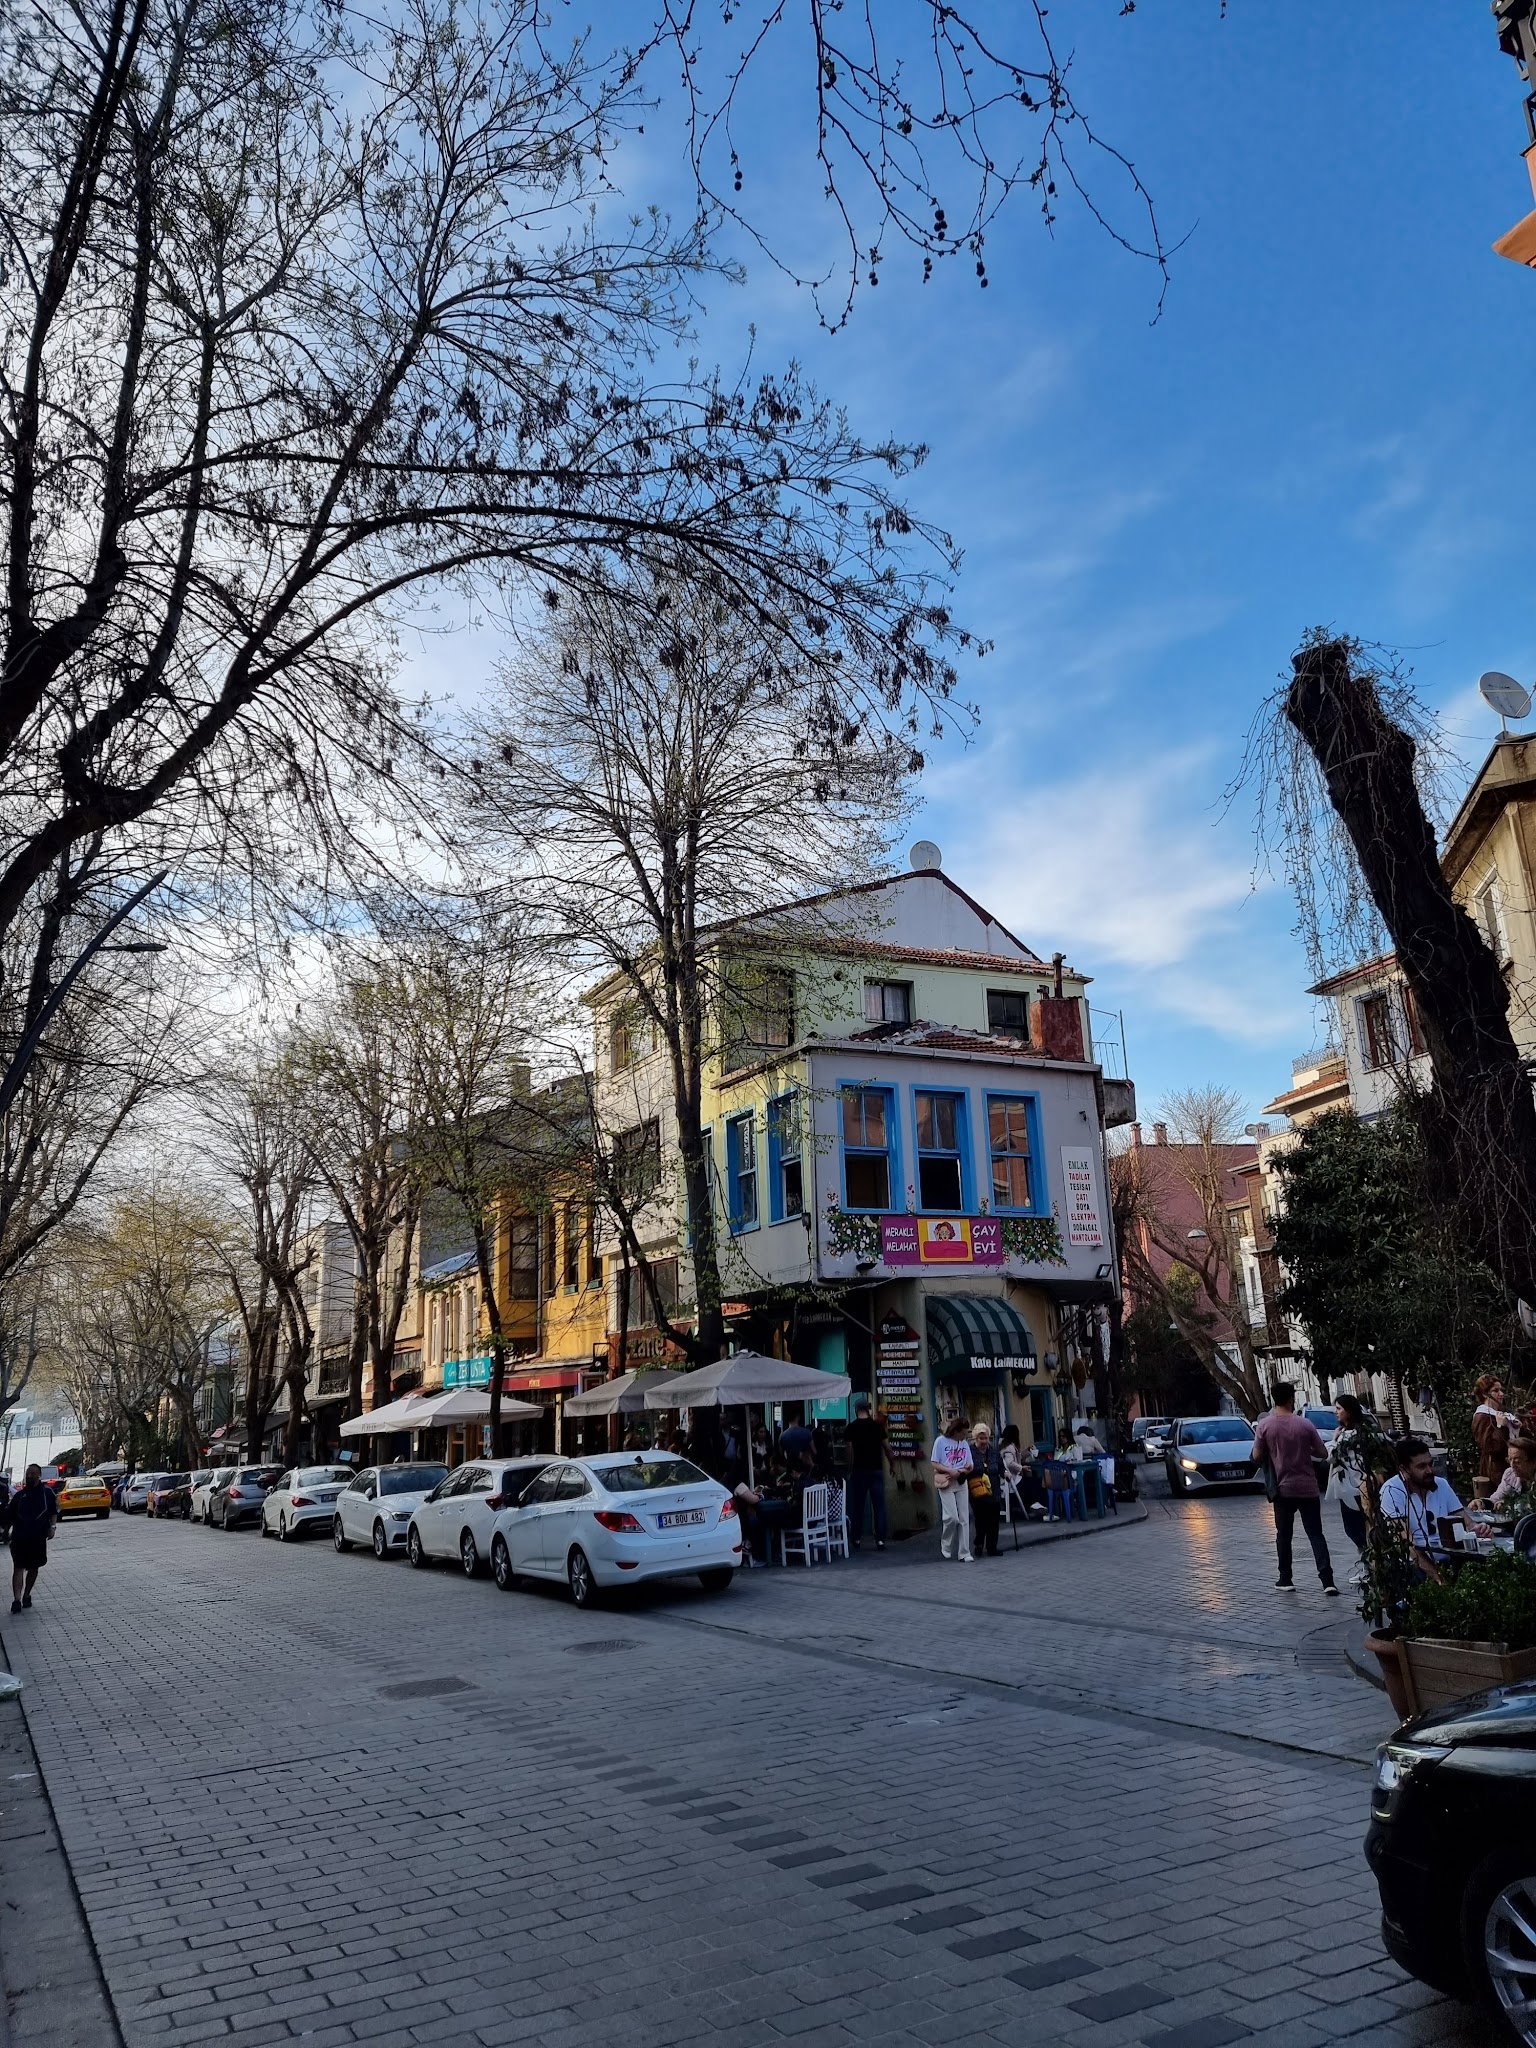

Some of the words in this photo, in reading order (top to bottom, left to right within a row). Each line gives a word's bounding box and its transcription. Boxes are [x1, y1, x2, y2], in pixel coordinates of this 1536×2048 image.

[1068, 1161, 1088, 1169] EMLAK
[1069, 1172, 1090, 1180] TADİLAT
[1076, 1194, 1088, 1203] ÇATI
[1076, 1203, 1090, 1211] BOYA
[886, 1228, 914, 1237] MERAKLI
[973, 1226, 996, 1238] ÇAY
[1072, 1233, 1101, 1242] MANTOLAMA
[887, 1243, 918, 1251] MELAHAT
[974, 1241, 997, 1254] EVİ
[663, 1516, 673, 1525] 34
[691, 1511, 704, 1521] 482
